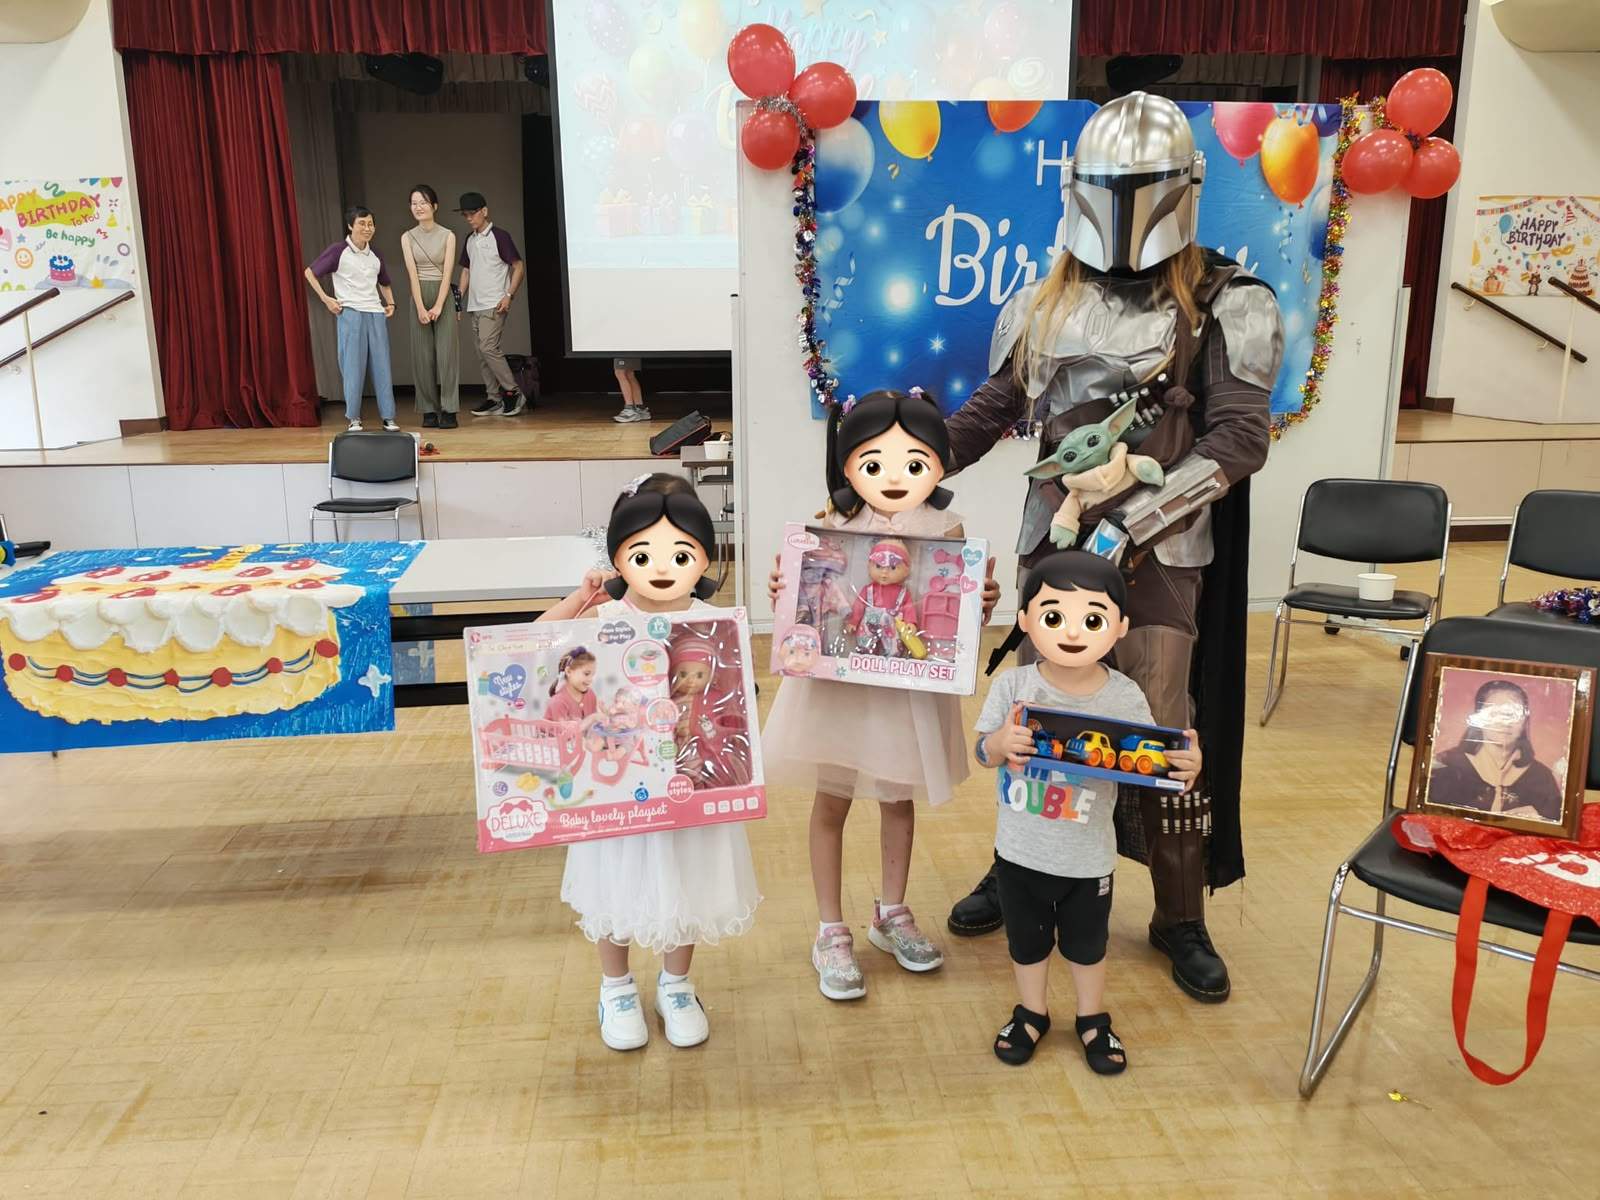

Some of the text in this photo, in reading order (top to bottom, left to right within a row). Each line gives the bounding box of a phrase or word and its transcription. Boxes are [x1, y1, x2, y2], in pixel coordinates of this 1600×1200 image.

[0, 188, 37, 212] APPY
[17, 194, 100, 228] BIRTHDAY
[1520, 217, 1559, 233] HAPPY
[46, 229, 95, 247] Be happy
[1506, 229, 1566, 251] BIRTHDAY
[851, 655, 956, 680] DOLL PLAY SET
[492, 811, 544, 832] DELUXE
[560, 812, 589, 830] Baby
[591, 808, 625, 825] lovely
[628, 802, 668, 823] playset
